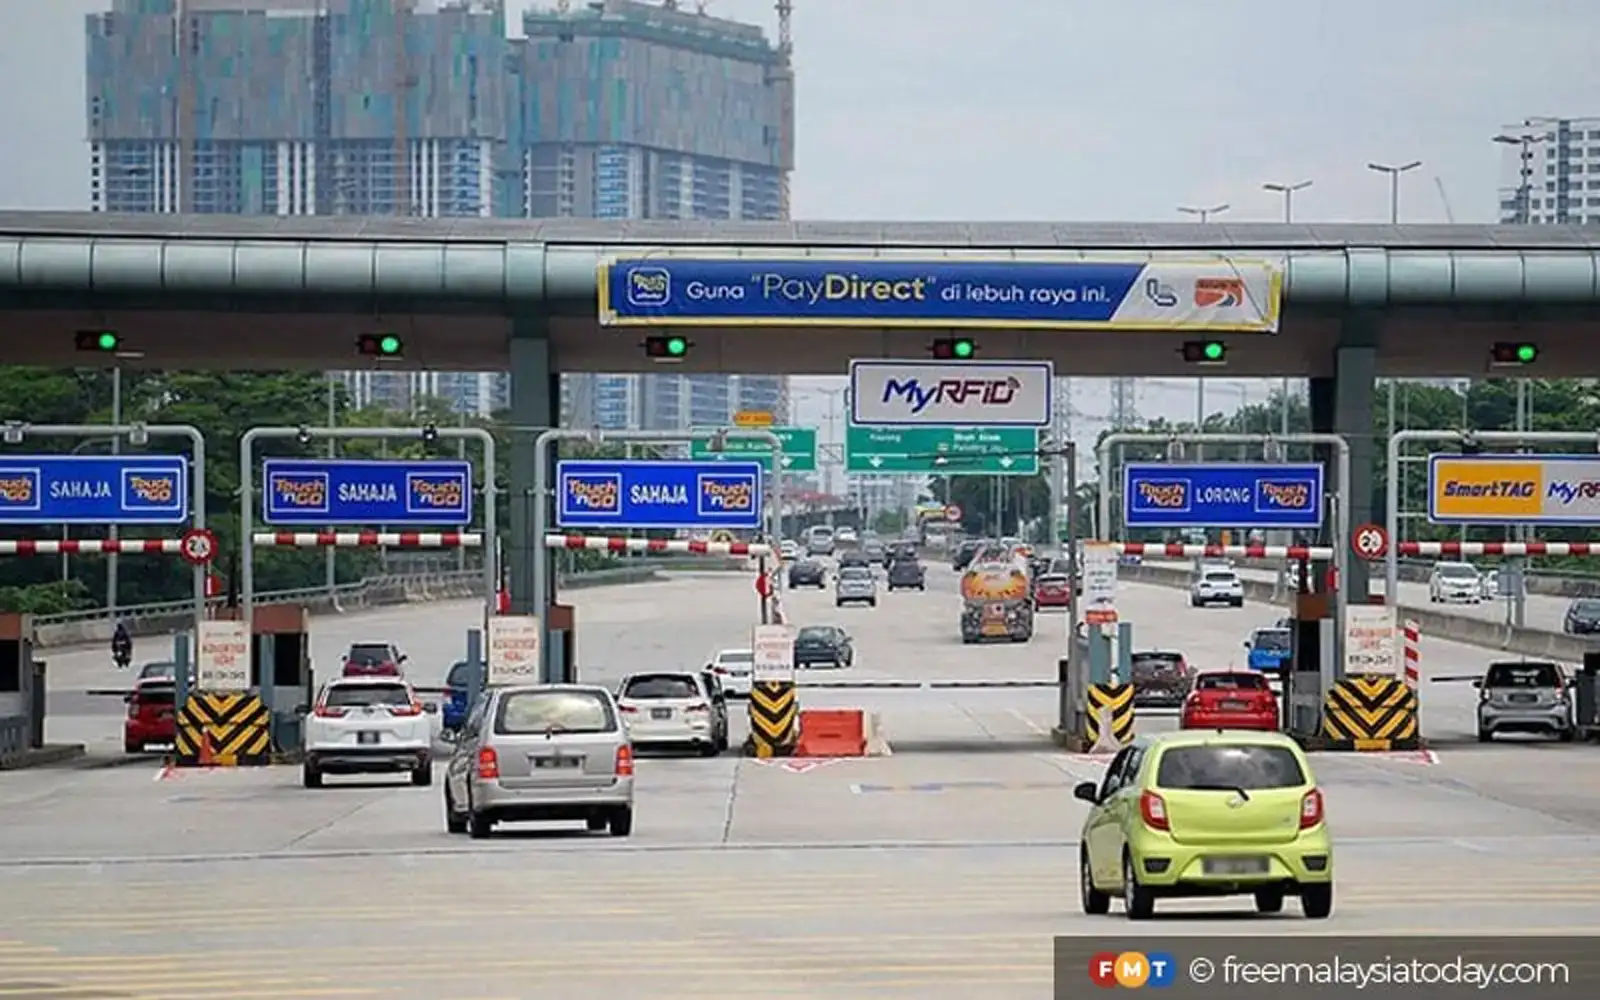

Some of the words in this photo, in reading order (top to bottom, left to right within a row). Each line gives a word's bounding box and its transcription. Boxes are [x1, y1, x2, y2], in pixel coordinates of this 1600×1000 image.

[686, 281, 744, 300] Guna
[941, 284, 961, 301] di
[966, 284, 1024, 302] lebuh
[1029, 288, 1076, 305] raya
[50, 481, 112, 498] SAHAJA
[338, 483, 397, 502] SAHAJA
[630, 485, 688, 504] SAHAJA
[1196, 487, 1251, 504] LORONG
[1443, 480, 1536, 498] SmartTAG
